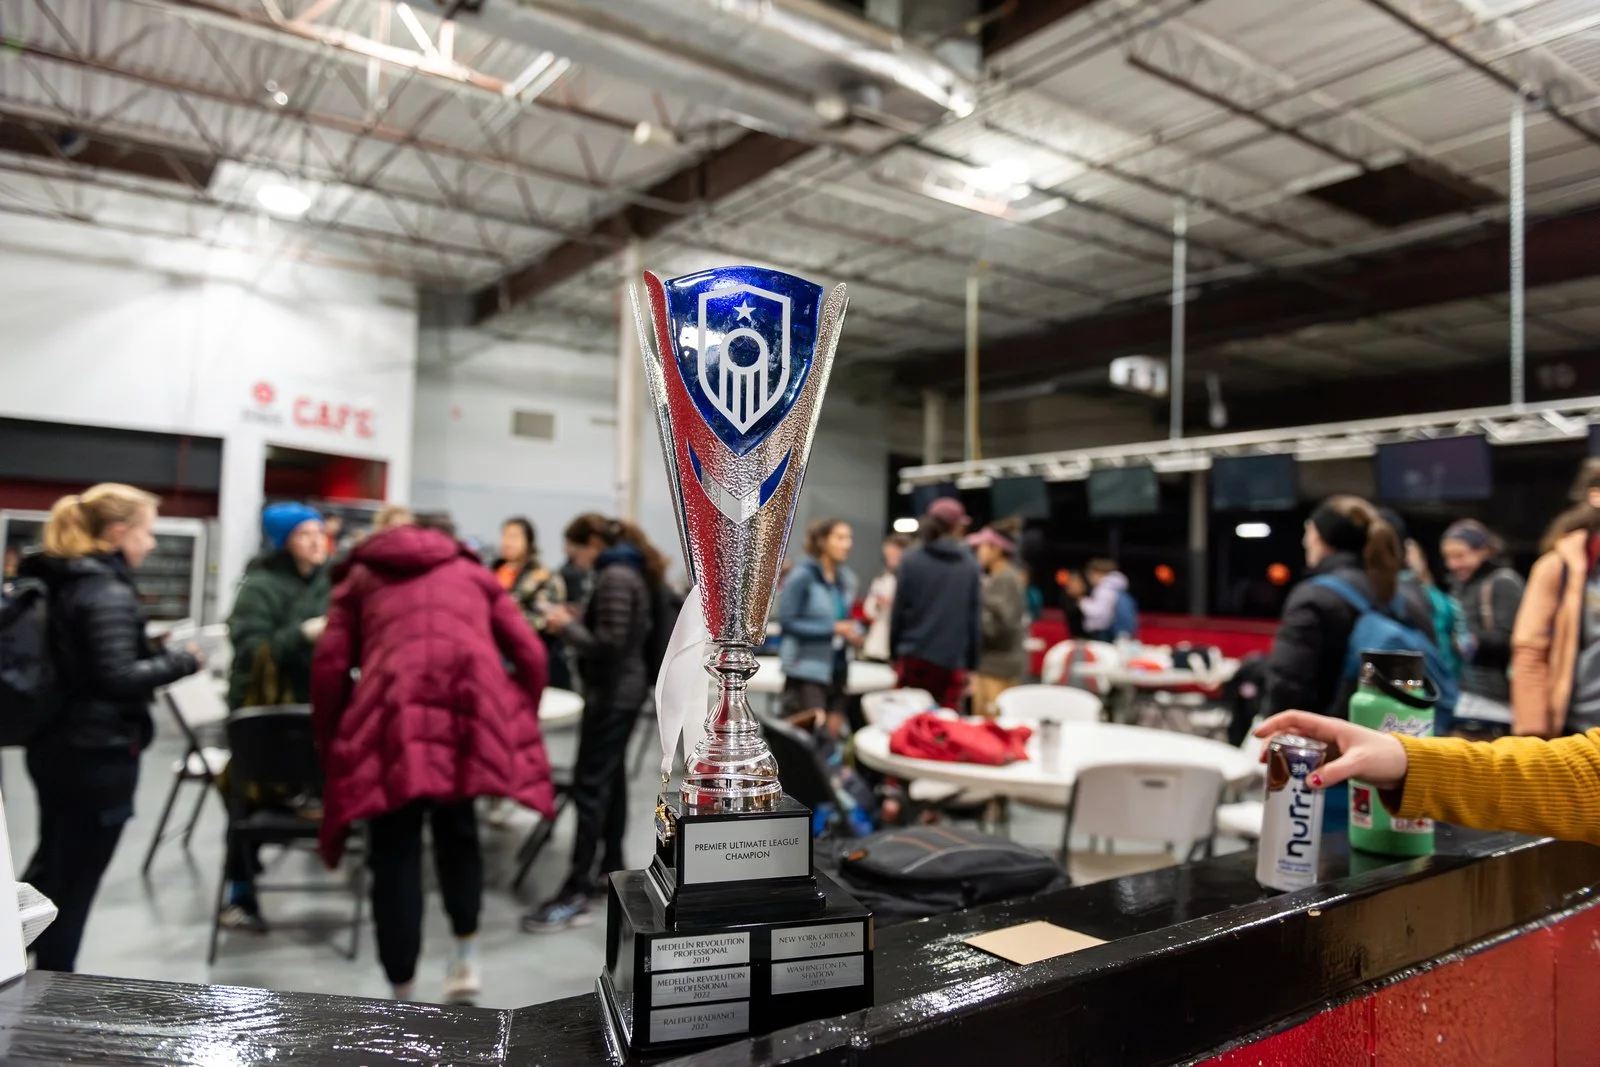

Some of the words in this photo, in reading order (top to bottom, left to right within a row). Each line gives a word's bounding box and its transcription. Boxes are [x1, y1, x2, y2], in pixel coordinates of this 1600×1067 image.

[1287, 788, 1312, 858] nurri
[694, 842, 727, 852] PREMIER
[729, 839, 767, 849] ULTIMATE
[769, 837, 800, 847] LEAGUE
[725, 850, 770, 861] CHAMPION
[779, 936, 796, 945] NEW
[798, 934, 817, 942] YORK
[819, 931, 856, 941] GRIDLOCK
[657, 940, 694, 952] MEDELLÍN
[696, 937, 745, 948] REVOLUTION
[810, 941, 826, 949] 2024
[673, 947, 728, 958] PROFESSIONAL
[692, 956, 710, 964] 2019
[786, 961, 837, 973] WASHINGTON
[657, 976, 694, 987] MEDELLÍN
[697, 972, 746, 983] REVOLUTION
[801, 970, 835, 980] SHADOW
[674, 982, 728, 993] PROFESSIONAL
[693, 991, 711, 999] 2022
[663, 1016, 696, 1026] RALEIGH
